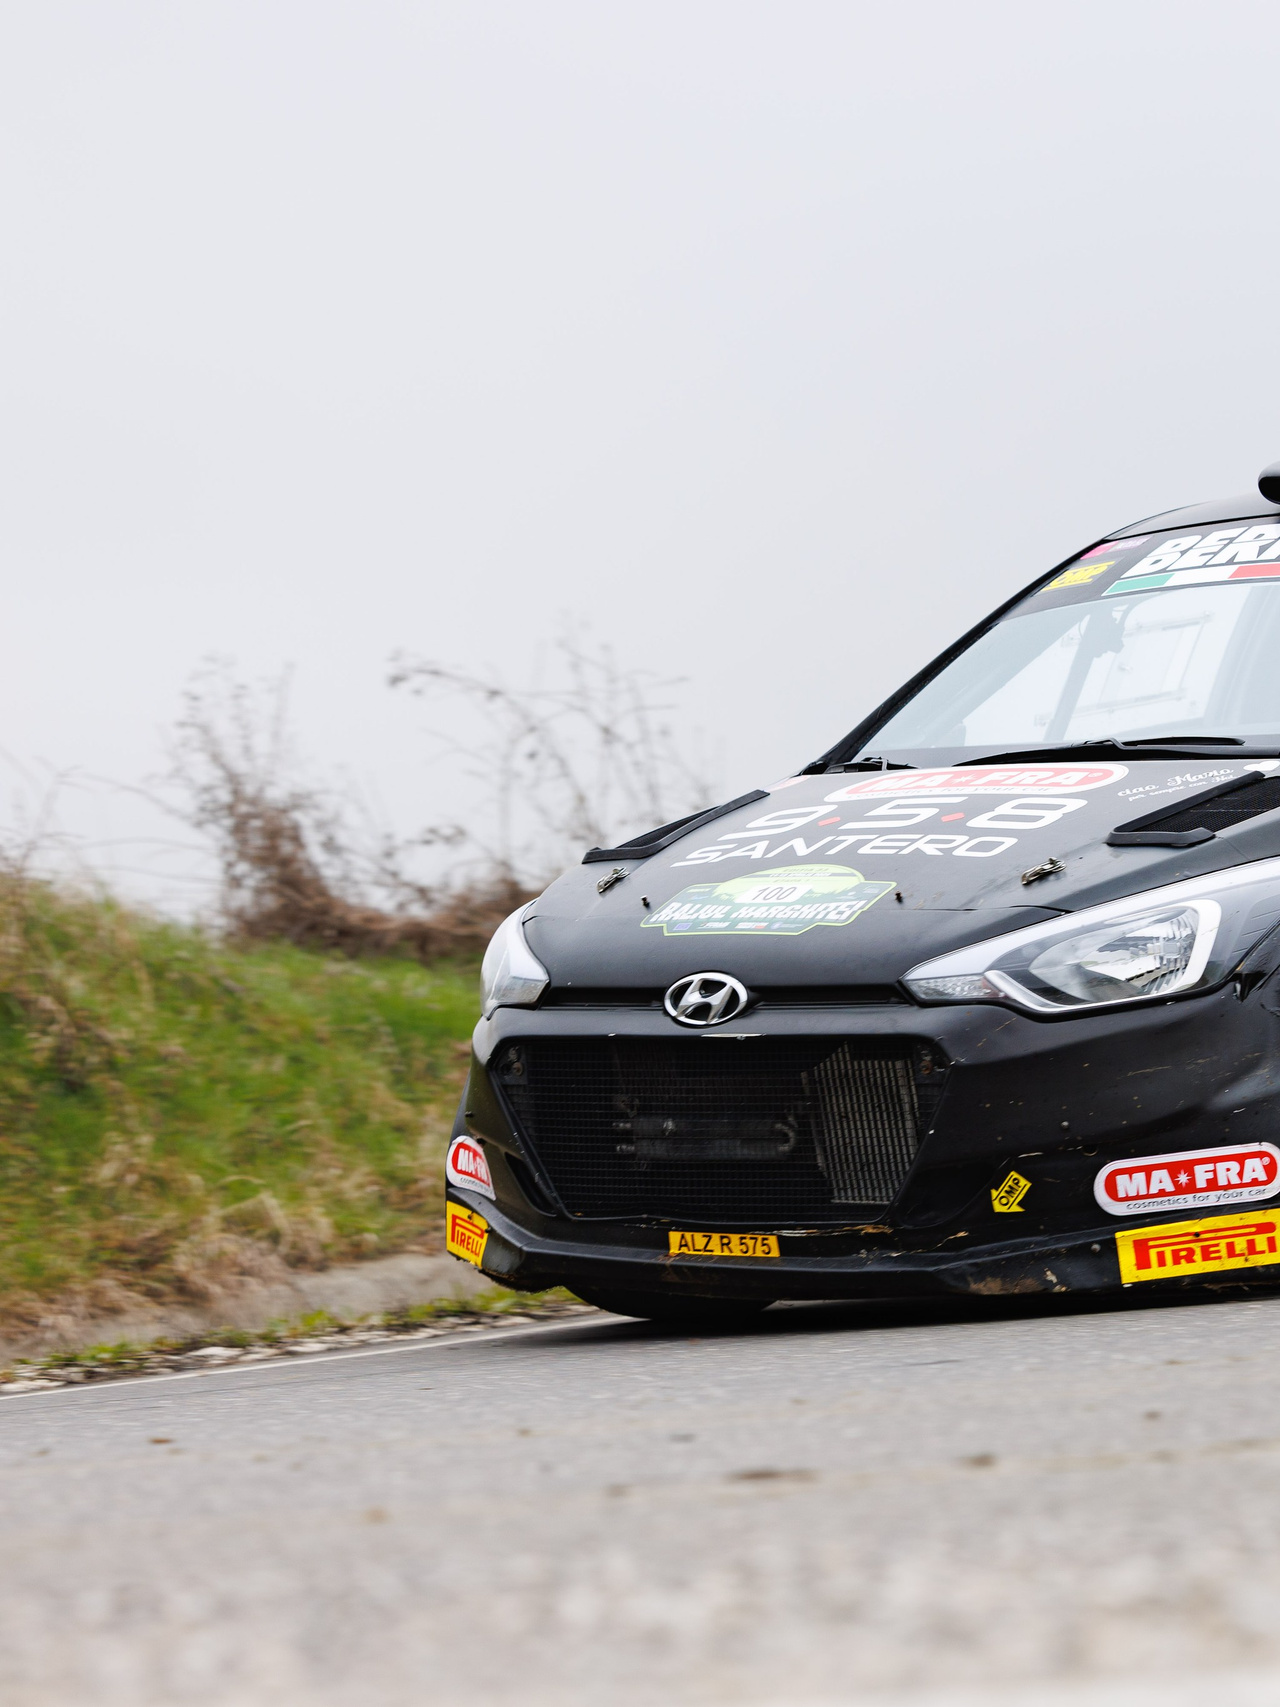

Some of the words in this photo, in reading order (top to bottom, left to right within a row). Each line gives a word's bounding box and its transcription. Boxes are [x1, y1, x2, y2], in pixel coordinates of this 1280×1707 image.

[670, 834, 1019, 868] SANTERO
[750, 886, 798, 900] 100
[650, 902, 735, 921] RALIUL
[999, 1176, 1021, 1207] OMP
[1126, 1194, 1189, 1210] cosmetics
[1192, 1192, 1211, 1204] for
[1215, 1190, 1244, 1203] your
[1248, 1187, 1267, 1197] car
[451, 1214, 485, 1257] PIRELLI
[678, 1233, 715, 1253] ALZ
[720, 1235, 734, 1253] R
[739, 1235, 771, 1255] 575
[1132, 1222, 1277, 1270] PIRELLI
